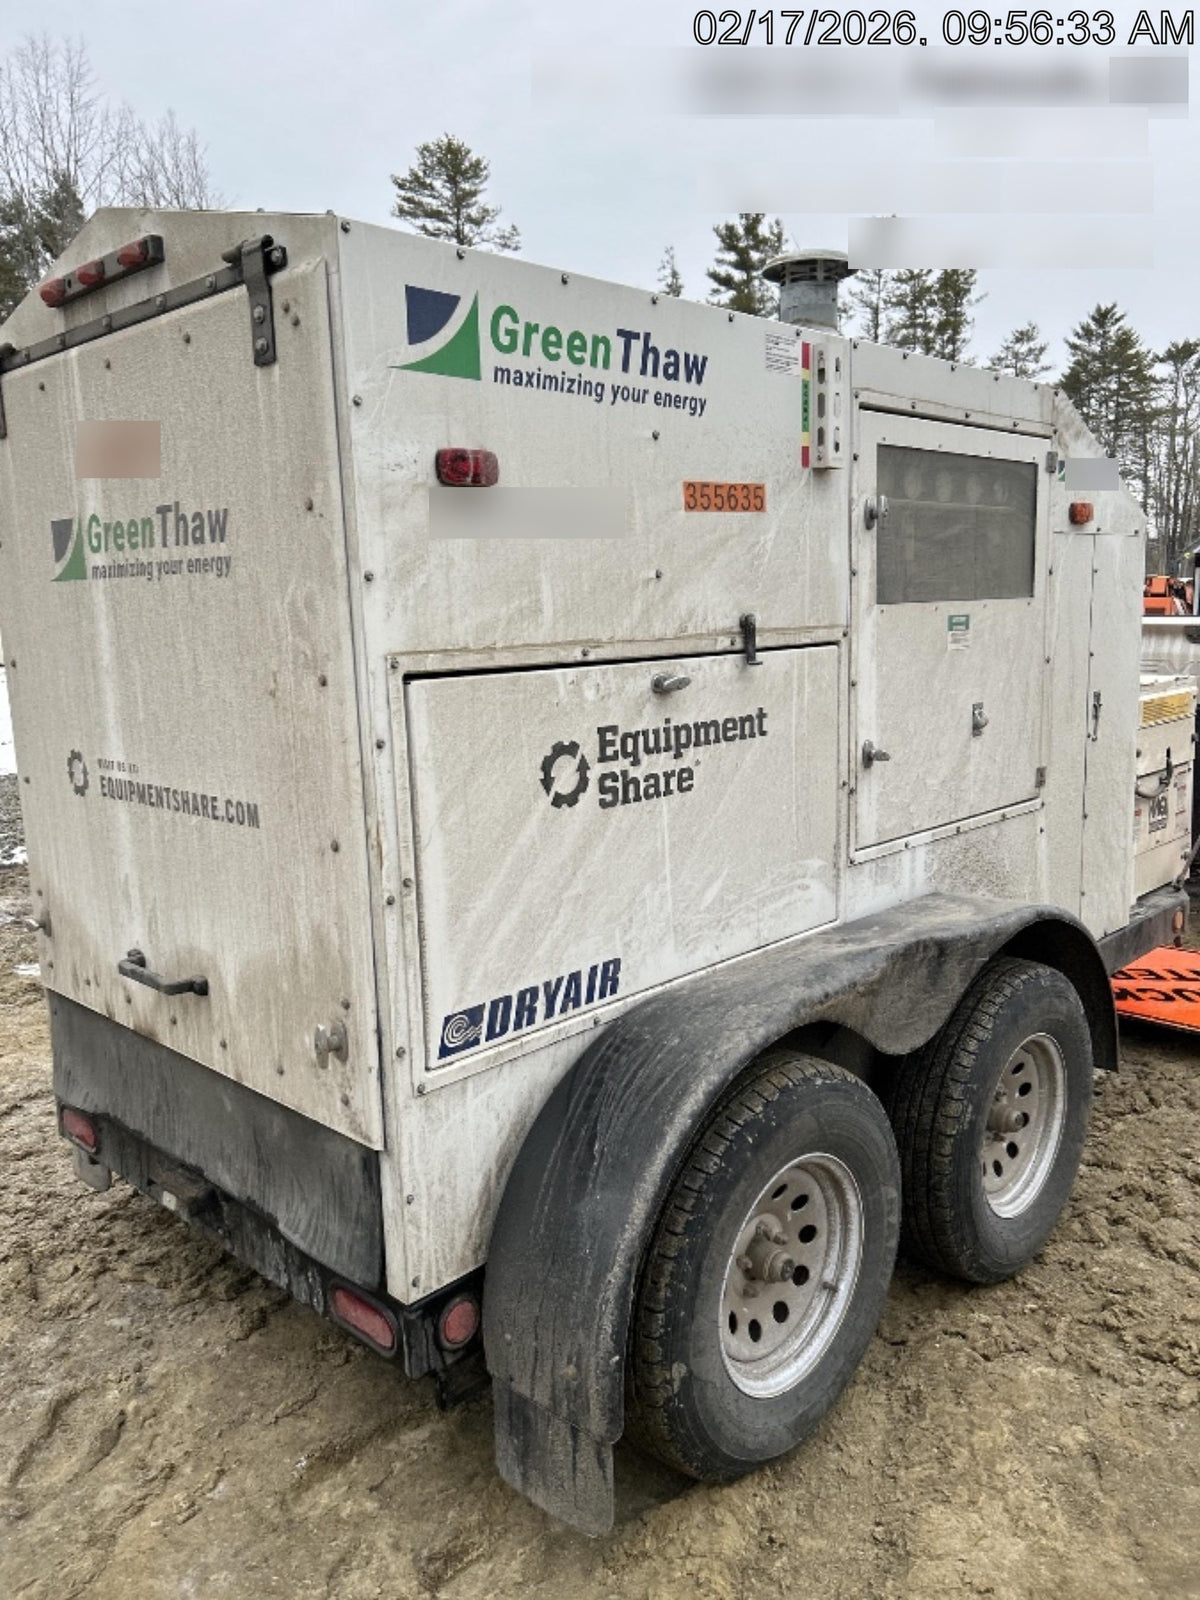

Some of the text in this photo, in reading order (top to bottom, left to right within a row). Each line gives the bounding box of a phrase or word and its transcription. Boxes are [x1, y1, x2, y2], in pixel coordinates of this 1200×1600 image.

[489, 304, 708, 386] GreenThaw
[493, 365, 707, 417] maximizing your energy
[686, 483, 764, 511] 355635
[87, 501, 228, 554] GreenThaw
[91, 556, 231, 581] maximizing your energy
[597, 707, 768, 767] Equipment
[99, 774, 260, 829] EQUIPMENTSHARE.COM
[485, 957, 622, 1043] DRYAIR
